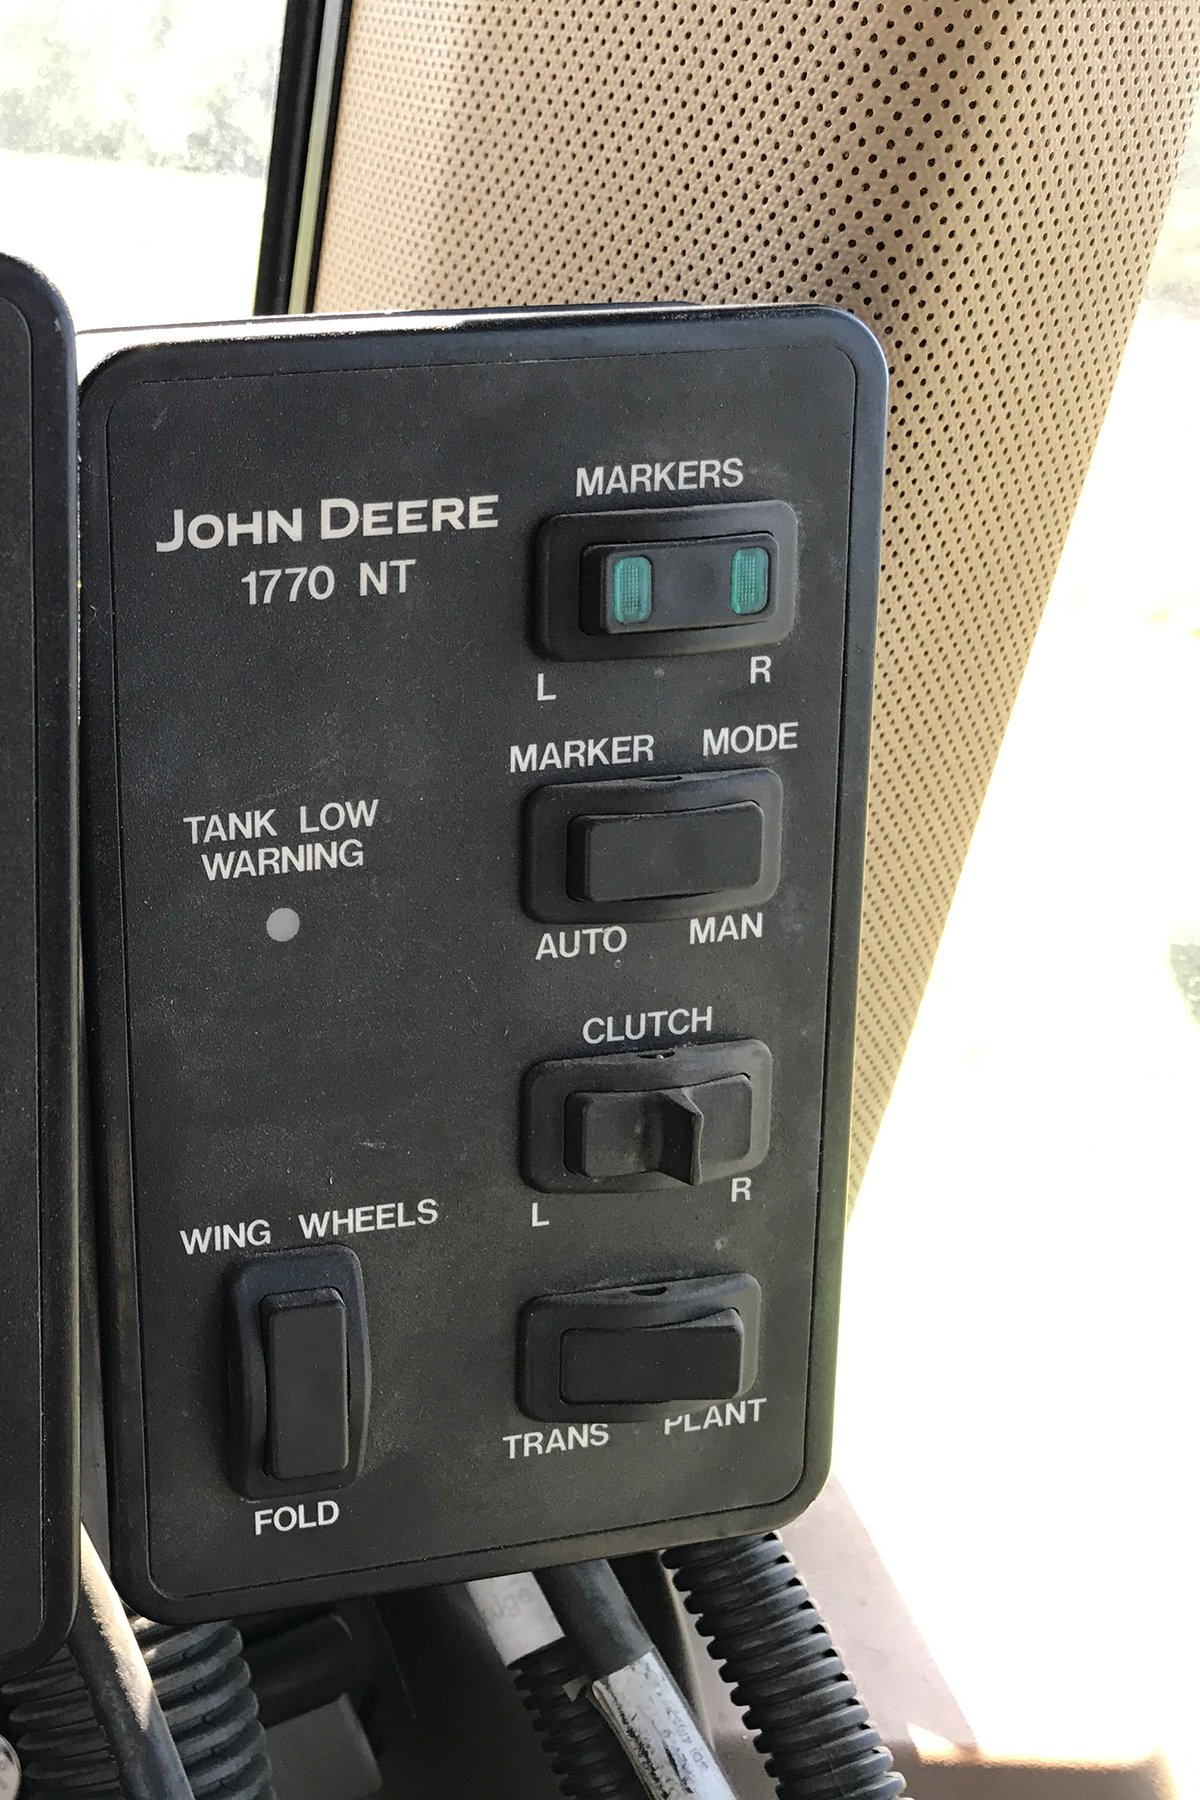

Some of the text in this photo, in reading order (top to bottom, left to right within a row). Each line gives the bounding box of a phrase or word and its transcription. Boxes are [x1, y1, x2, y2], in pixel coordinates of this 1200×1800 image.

[576, 457, 744, 498] MARKERS
[156, 494, 499, 553] JOHN DEERE
[241, 558, 417, 606] 1770 NT
[536, 673, 557, 702] L
[750, 655, 772, 685] R
[509, 721, 799, 774] MARKER MODE
[182, 797, 380, 846] TANK LOW
[200, 838, 365, 882] WARNING
[534, 924, 629, 962] AUTO
[689, 911, 763, 946] MAN
[581, 1005, 714, 1045] CLUTCH
[730, 1175, 752, 1204] R
[179, 1197, 440, 1256] WING WHEELS
[531, 1202, 550, 1228] L
[663, 1397, 768, 1436] PLANT
[502, 1422, 610, 1460] TRANS
[253, 1499, 341, 1536] FOLD
